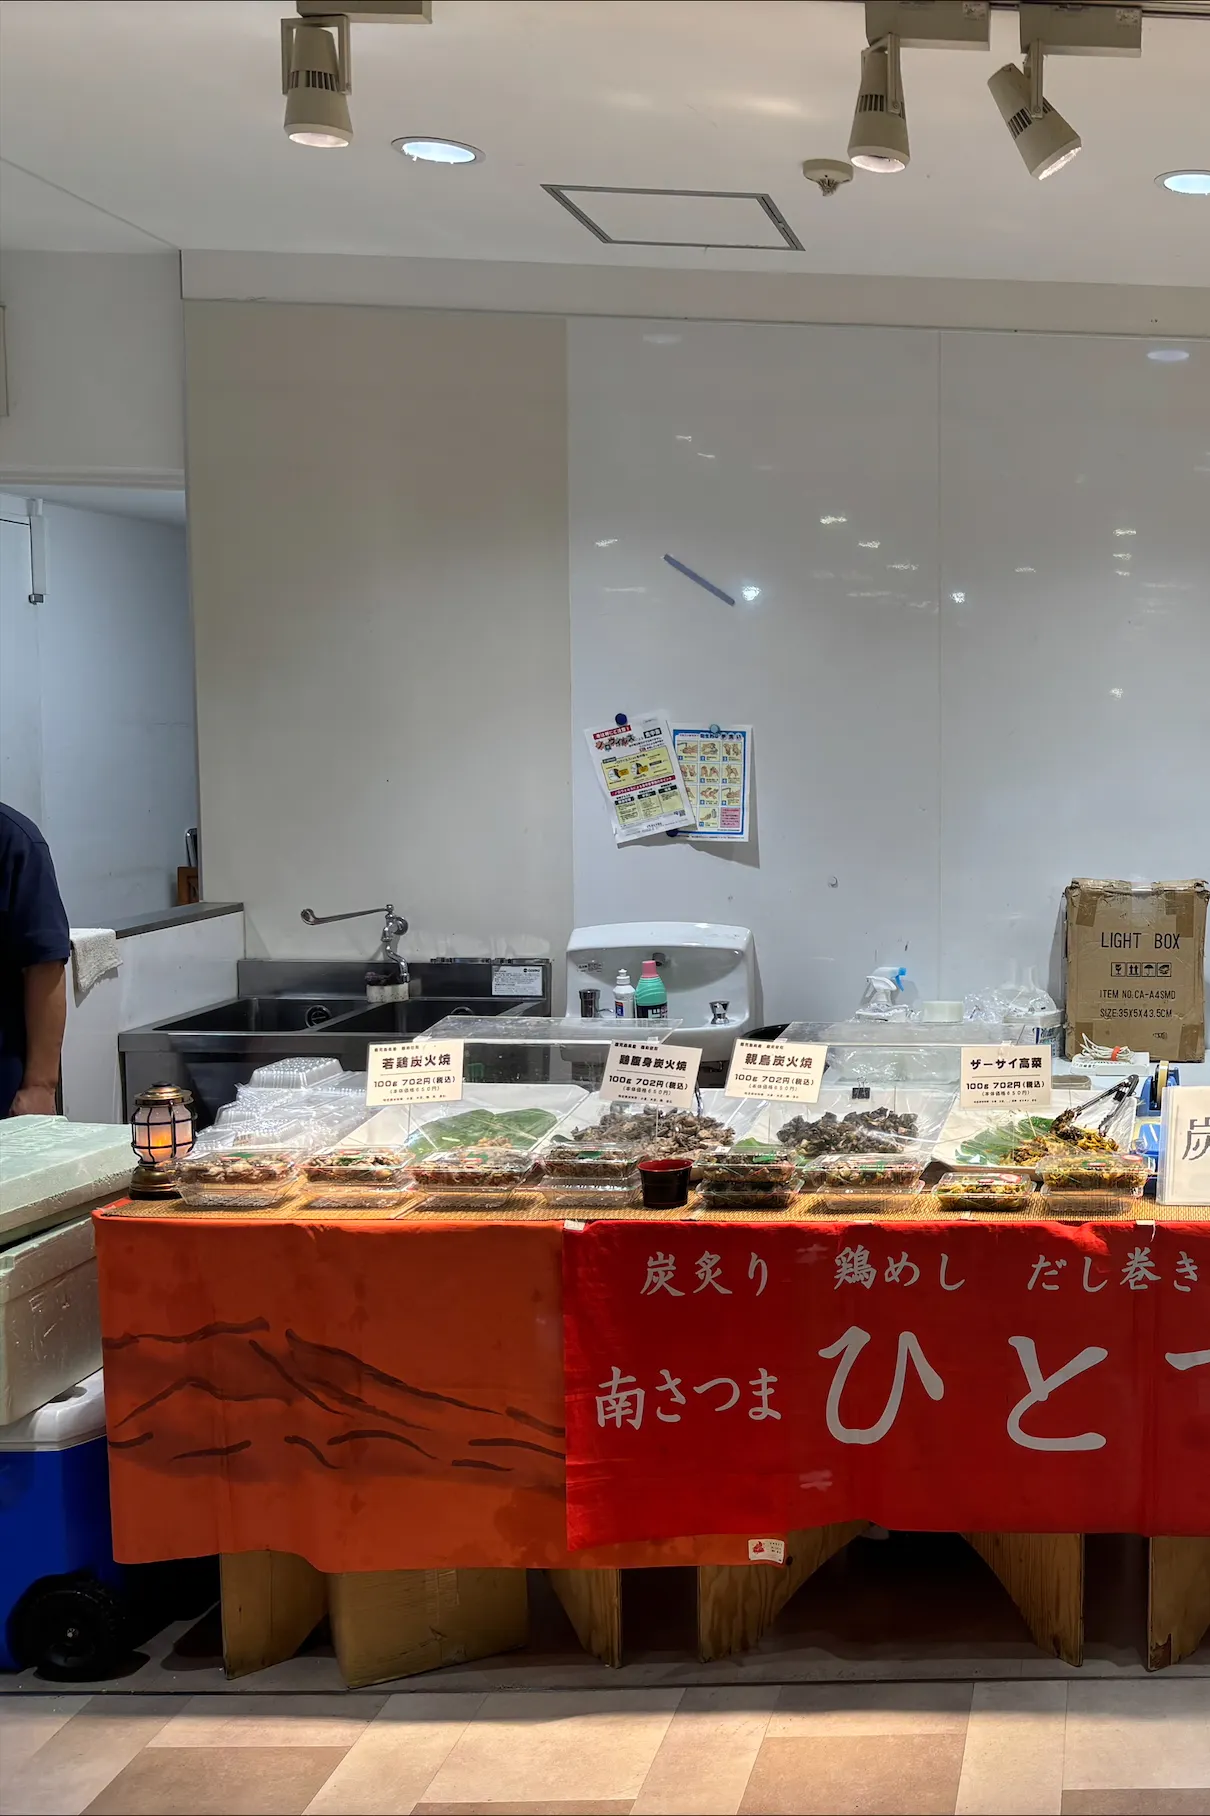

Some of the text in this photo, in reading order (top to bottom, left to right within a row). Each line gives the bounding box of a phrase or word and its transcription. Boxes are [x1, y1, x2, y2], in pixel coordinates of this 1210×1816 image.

[1101, 932, 1180, 949] LIGHT BOX
[1100, 990, 1119, 999] ITEM
[382, 1054, 451, 1070] 若鶏炭火焼
[970, 1057, 1042, 1070] ザーサイ高菜
[374, 1080, 398, 1088] 100g
[609, 1075, 632, 1085] 100g
[735, 1073, 758, 1082] 100g
[640, 1250, 769, 1296] 炭炙り
[833, 1244, 966, 1292] 鶏めし
[596, 1366, 782, 1430] 南さつま
